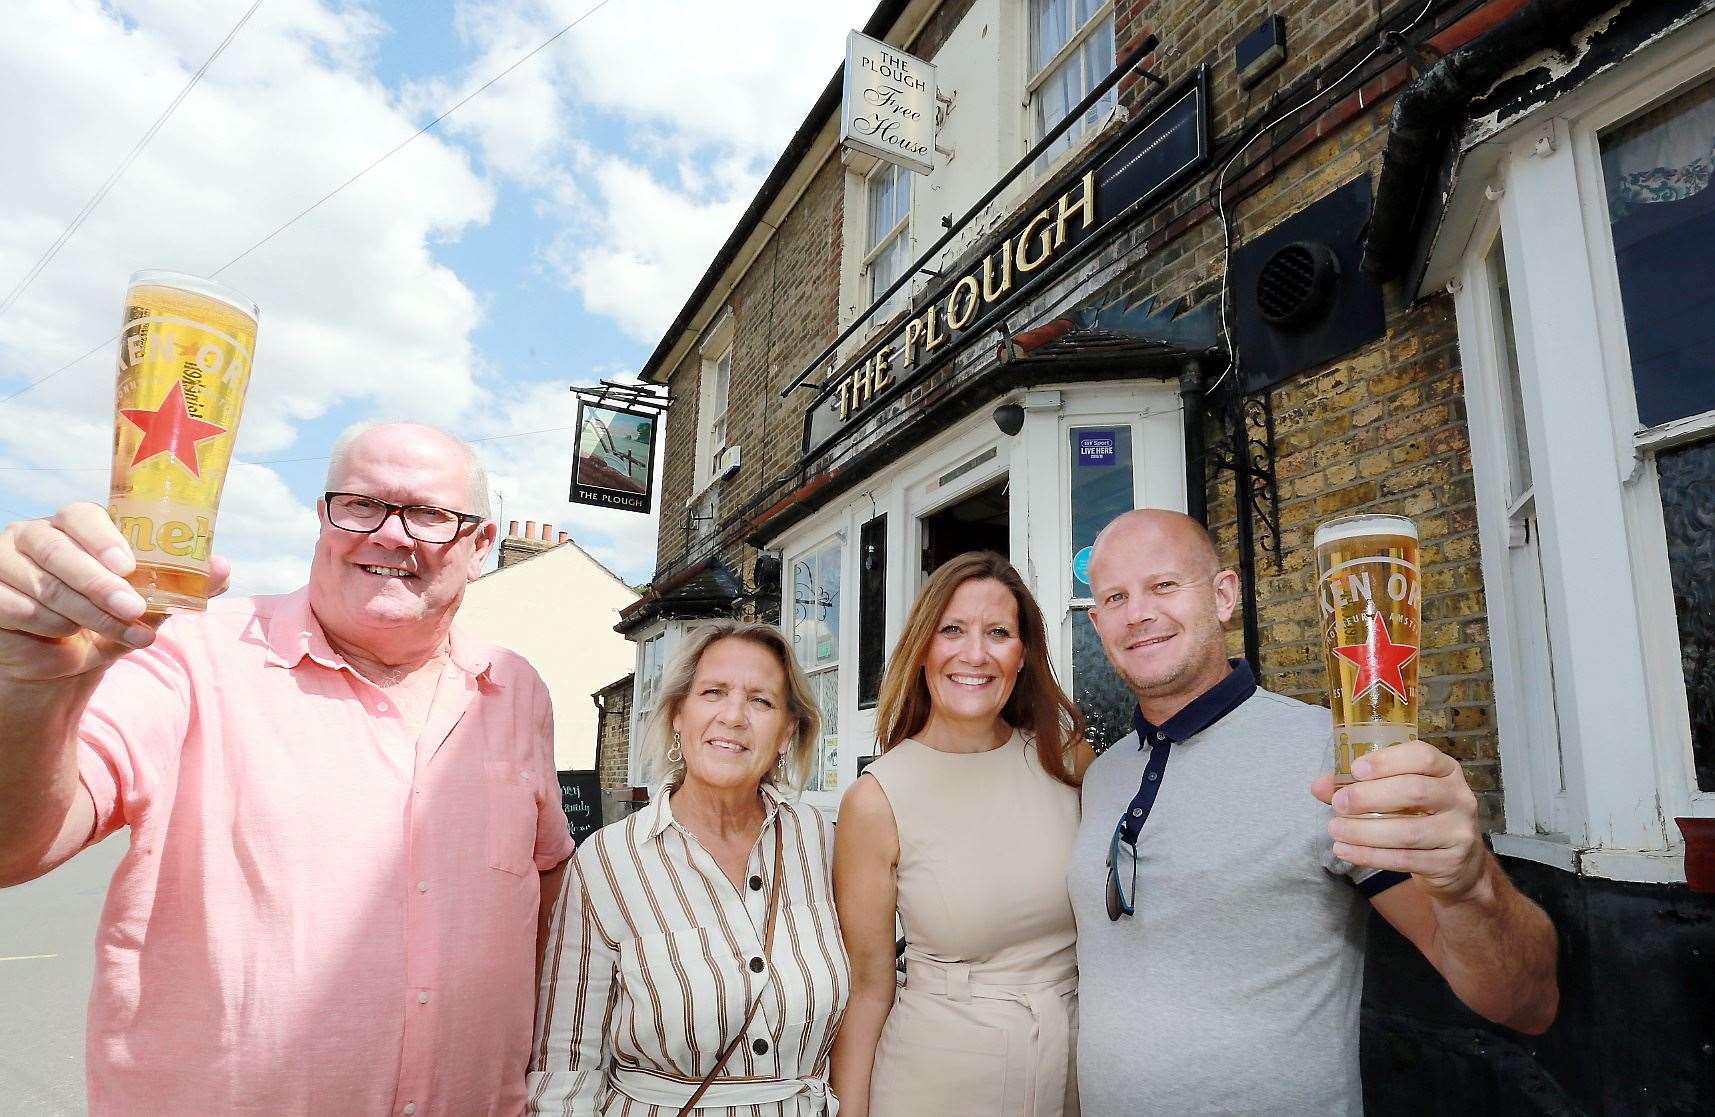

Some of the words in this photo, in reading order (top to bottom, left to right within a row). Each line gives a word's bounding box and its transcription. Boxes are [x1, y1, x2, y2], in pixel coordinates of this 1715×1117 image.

[862, 56, 926, 92] PLOUGH
[880, 50, 909, 73] THE
[863, 84, 922, 120] Free
[853, 112, 928, 156] House
[837, 344, 896, 422] THE
[903, 170, 1097, 368] PLOUGH
[1080, 447, 1096, 455] LIVE
[1095, 447, 1113, 455] HERE
[578, 490, 598, 500] THE
[602, 494, 643, 507] PLOUGH
